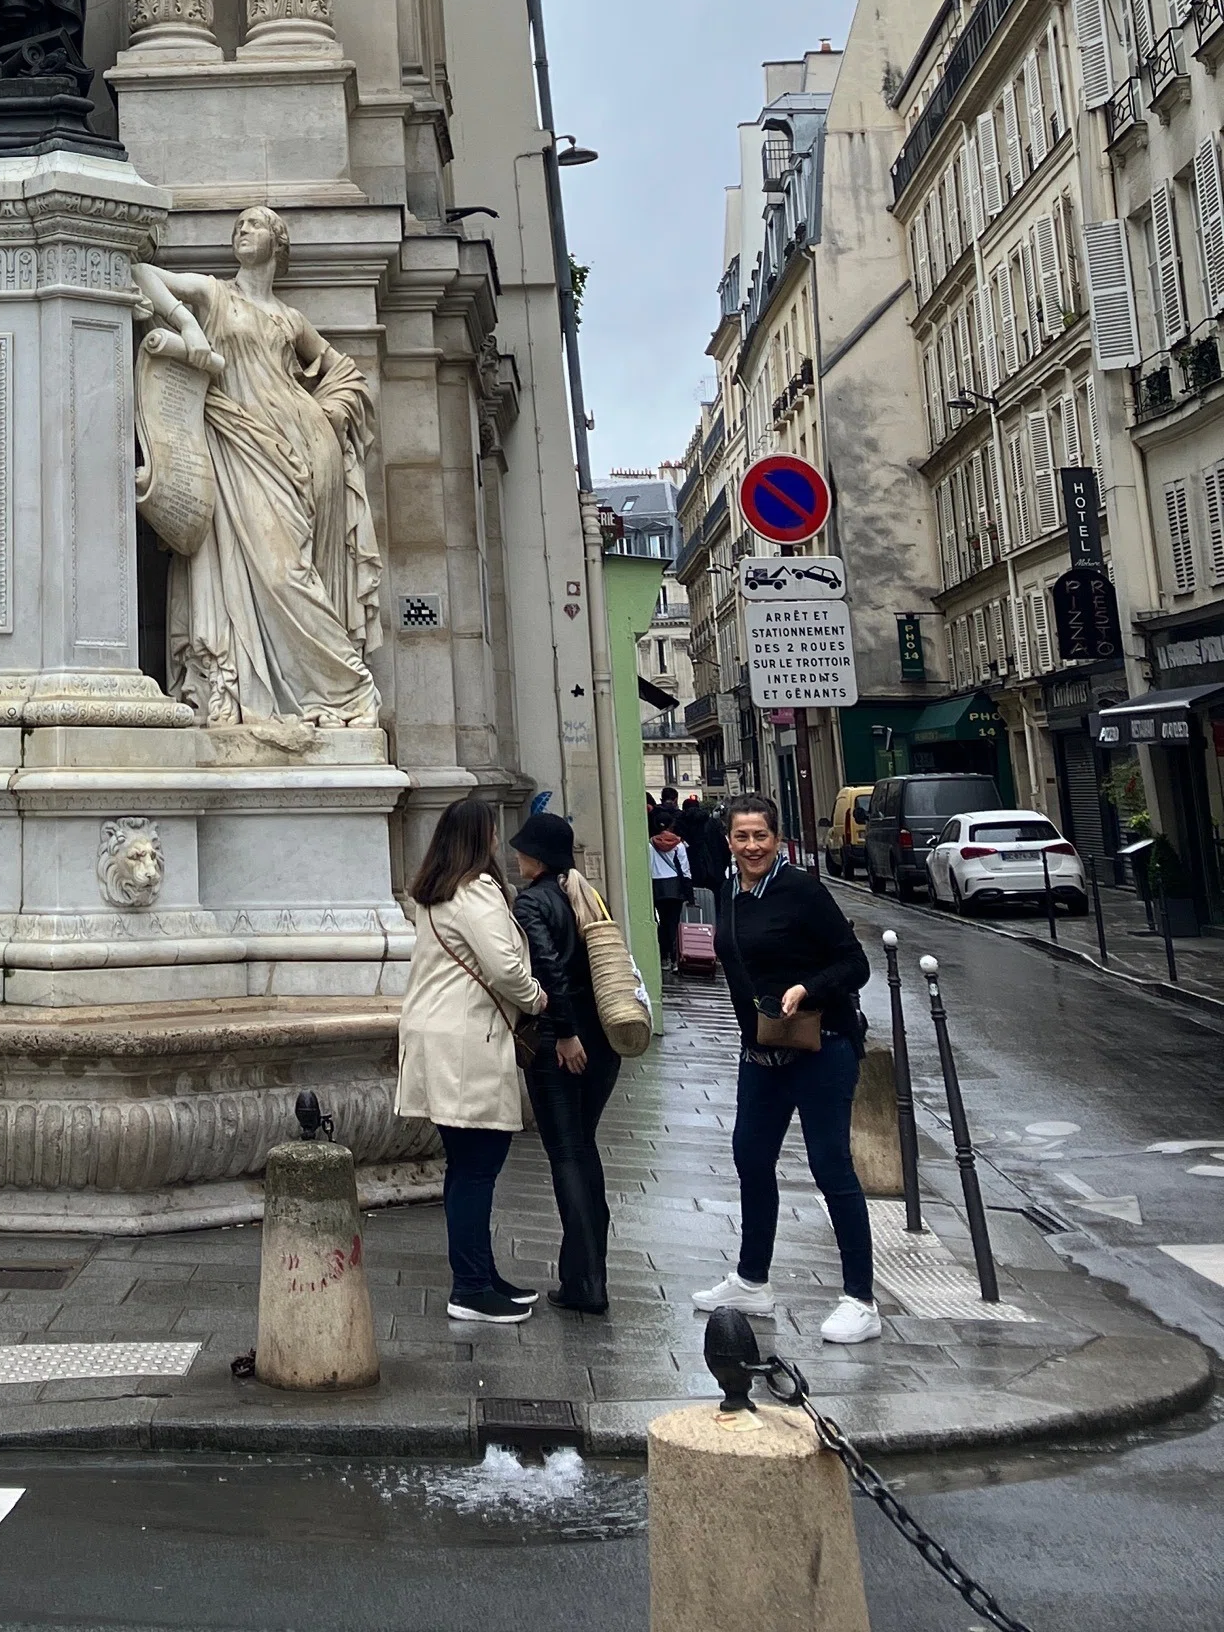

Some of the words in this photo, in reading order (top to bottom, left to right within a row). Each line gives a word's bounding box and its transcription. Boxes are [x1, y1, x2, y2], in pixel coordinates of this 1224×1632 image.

[1073, 483, 1090, 552] HOTEL
[766, 610, 808, 622] ARRÊT
[814, 611, 828, 620] ET
[1065, 580, 1089, 655] PIZZA
[1091, 580, 1114, 656] RESTO
[752, 626, 845, 638] STATIONNEMENT
[904, 625, 916, 649] PHO
[755, 643, 780, 653] DES
[787, 643, 794, 652] 2
[801, 641, 845, 652] ROUES
[904, 652, 919, 660] 14
[753, 659, 776, 669] SUR
[779, 659, 793, 668] LE
[796, 657, 851, 667] TROTTOIR
[768, 673, 839, 684] INTERDITS
[763, 690, 778, 700] ET
[785, 688, 847, 699] GÊNANTS
[979, 728, 996, 737] 14
